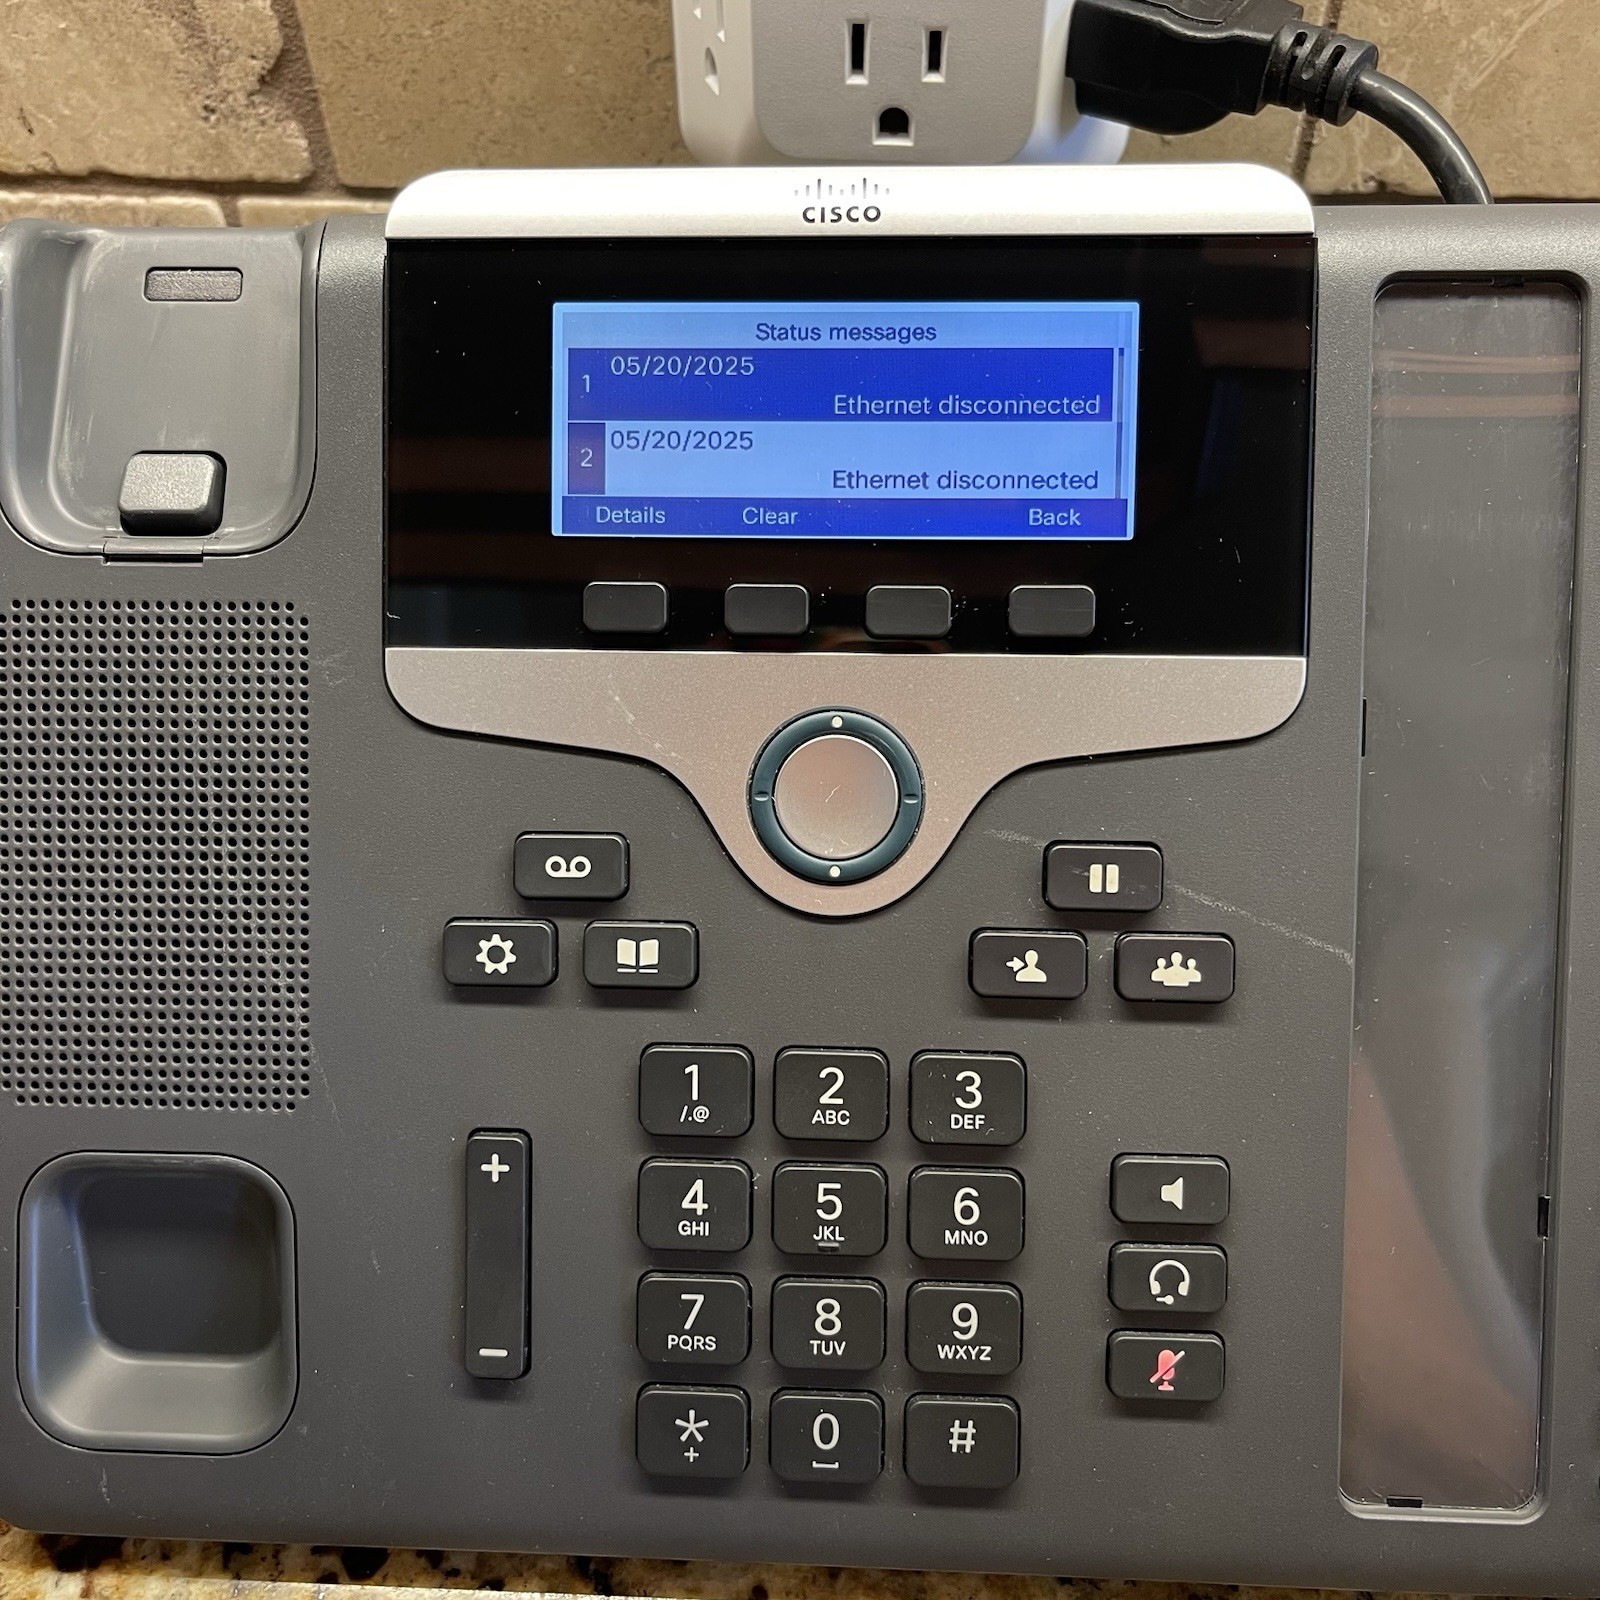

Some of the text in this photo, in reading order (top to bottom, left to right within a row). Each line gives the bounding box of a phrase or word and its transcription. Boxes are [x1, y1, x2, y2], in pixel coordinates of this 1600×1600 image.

[802, 206, 882, 224] CISCO
[755, 322, 938, 345] Status messages
[610, 356, 755, 377] 05/20/2025
[581, 374, 591, 394] 1
[834, 394, 1100, 416] Ethernet disconnected
[610, 430, 754, 451] 05/20/2025
[580, 448, 594, 467] 2
[832, 470, 1100, 490] Ethernet disconnected
[596, 506, 666, 524] Details
[742, 506, 798, 526] Clear
[1028, 508, 1081, 528] Back
[685, 1065, 698, 1100] 1
[820, 1067, 844, 1104] 2
[956, 1071, 982, 1108] 3
[812, 1110, 849, 1125] ABC
[951, 1114, 985, 1129] DEF
[682, 1179, 708, 1215] 4
[817, 1183, 842, 1220] 5
[954, 1188, 979, 1225] 6
[678, 1221, 709, 1236] GHI
[813, 1226, 844, 1240] JKL
[945, 1230, 987, 1245] MNO
[681, 1294, 704, 1329] 7
[815, 1299, 841, 1335] 8
[953, 1303, 977, 1340] 9
[668, 1335, 716, 1351] PQRS
[810, 1340, 845, 1355] TUV
[938, 1345, 991, 1360] WXYZ
[814, 1411, 839, 1449] 0
